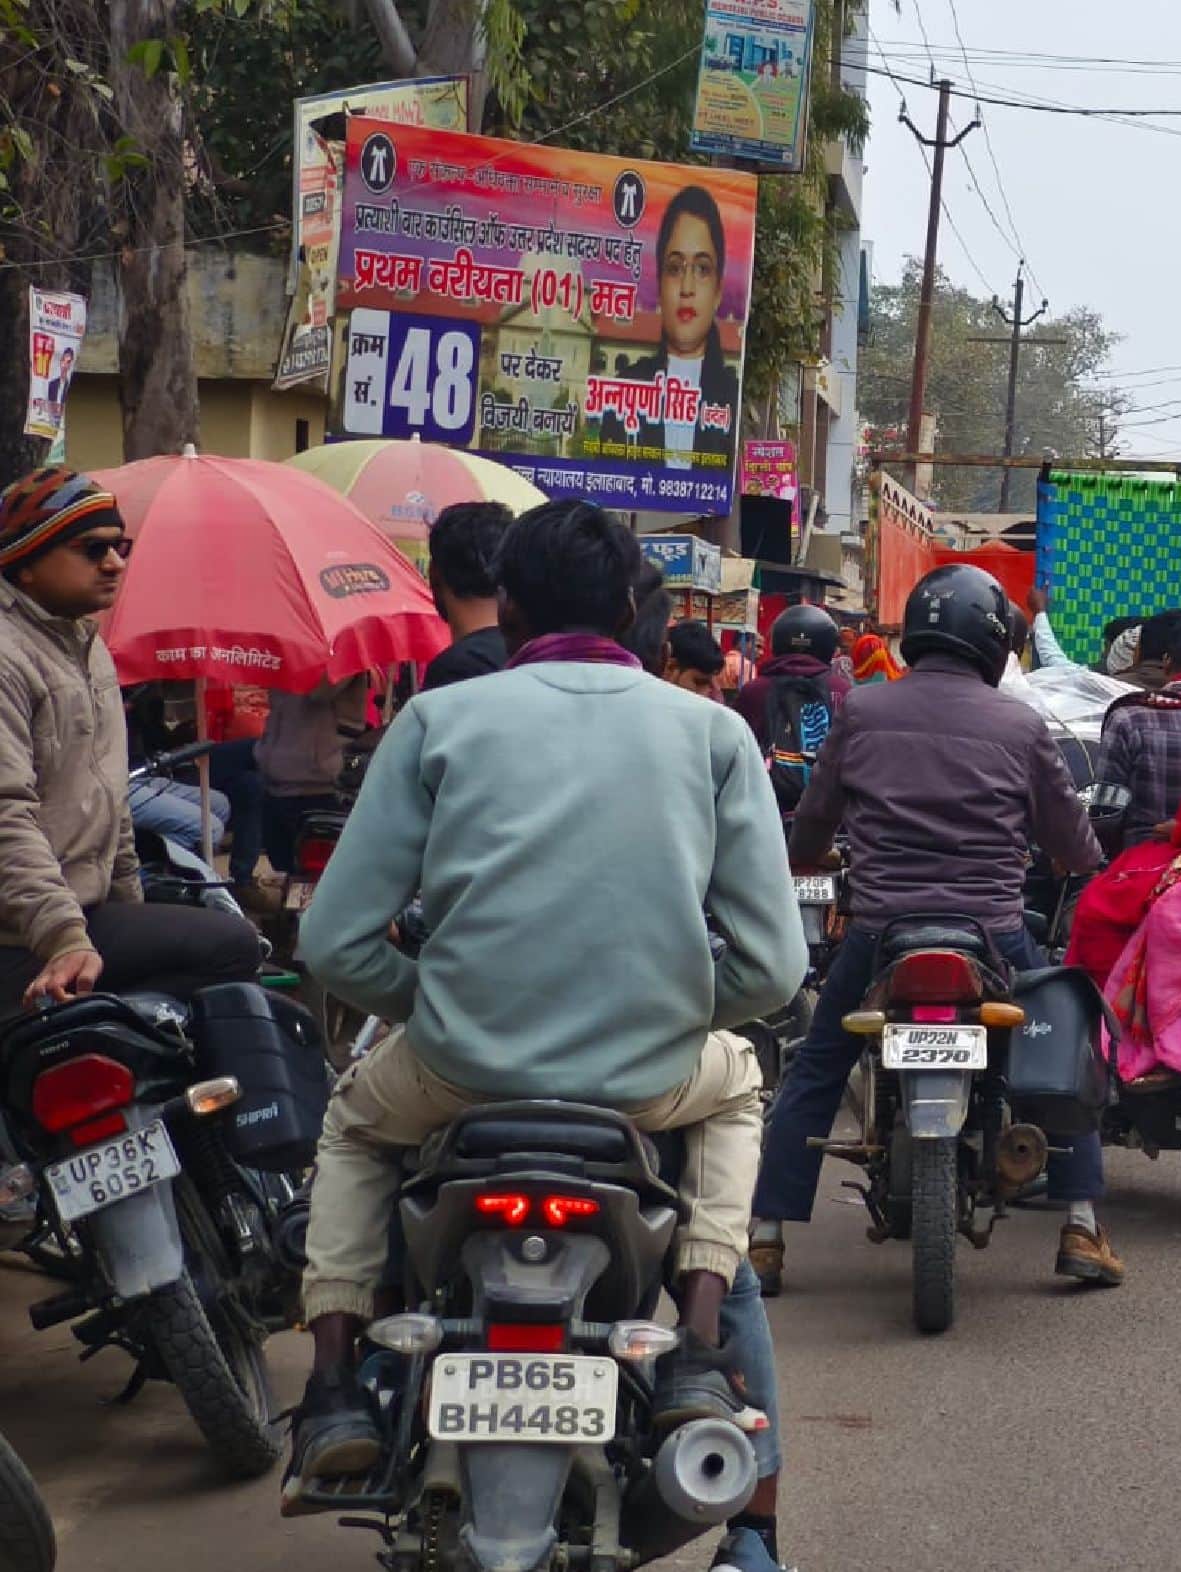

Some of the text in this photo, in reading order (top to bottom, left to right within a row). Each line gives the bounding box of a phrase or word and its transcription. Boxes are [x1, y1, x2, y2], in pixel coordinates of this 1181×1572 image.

[354, 197, 400, 234] प्रत्याशी
[354, 246, 637, 322] प्रथम वरीयता (01) मत
[351, 332, 387, 358] क्रम
[390, 327, 474, 430] 48
[501, 347, 563, 382] पर देकर
[480, 392, 529, 432] विजयी
[583, 370, 665, 432] अन्नपूर्णा
[664, 375, 702, 424] सिंह
[537, 468, 584, 490] न्यायालय
[901, 1049, 971, 1063] 2370
[236, 1101, 279, 1128] SHIPRA
[69, 1131, 153, 1184] UP36K
[89, 1157, 159, 1203] 6052
[468, 1358, 576, 1391] PB65
[438, 1403, 605, 1437] BH4483
